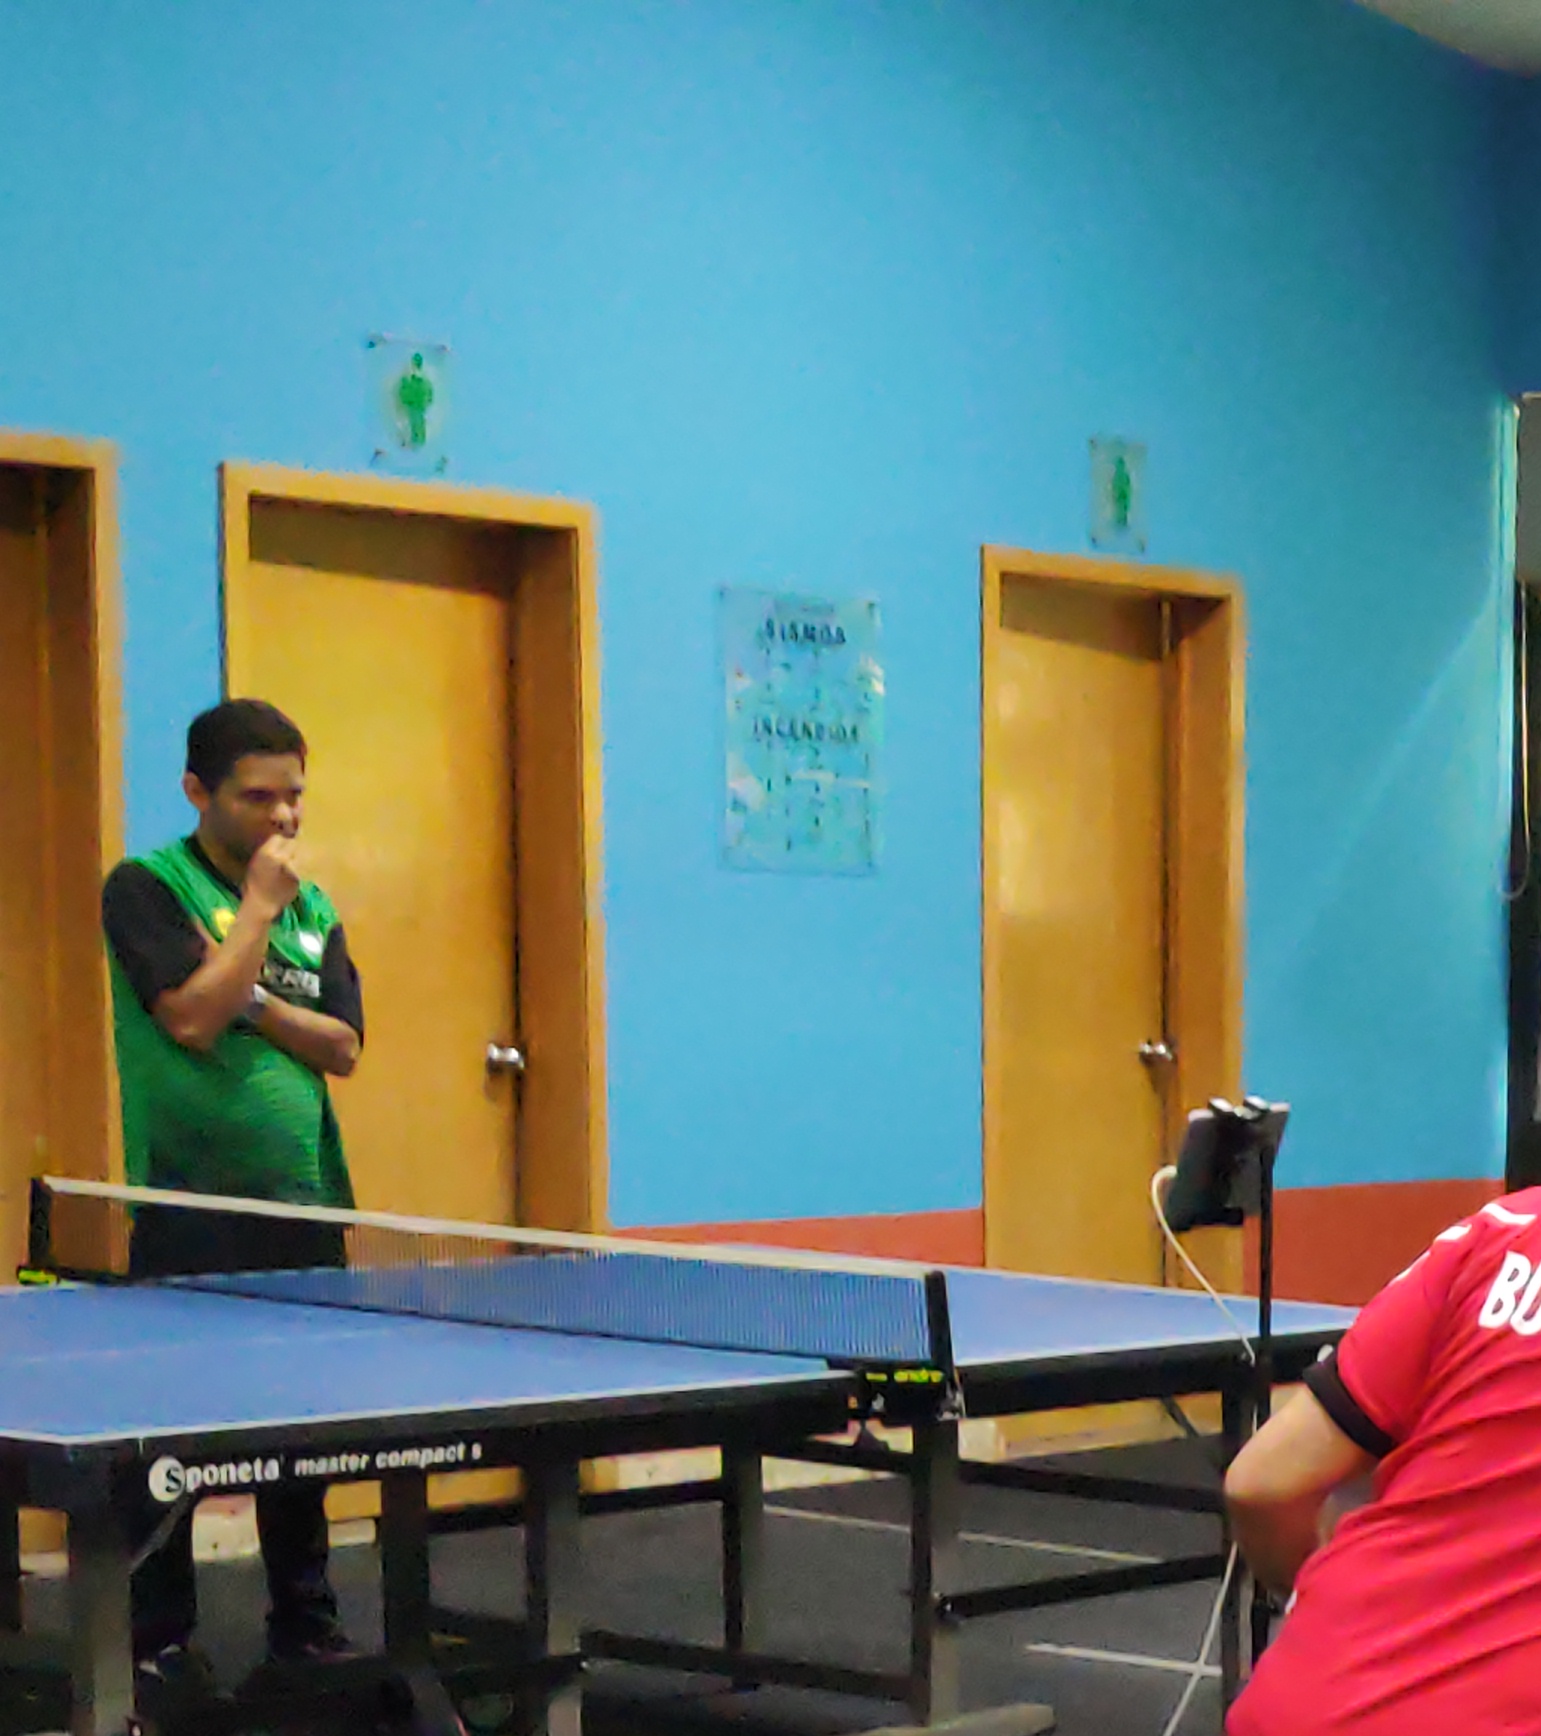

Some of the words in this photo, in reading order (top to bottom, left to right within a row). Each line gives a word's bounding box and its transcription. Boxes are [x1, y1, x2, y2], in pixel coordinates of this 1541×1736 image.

[147, 1454, 280, 1502] Sponeta
[294, 1453, 370, 1476] master
[376, 1442, 465, 1469] compact
